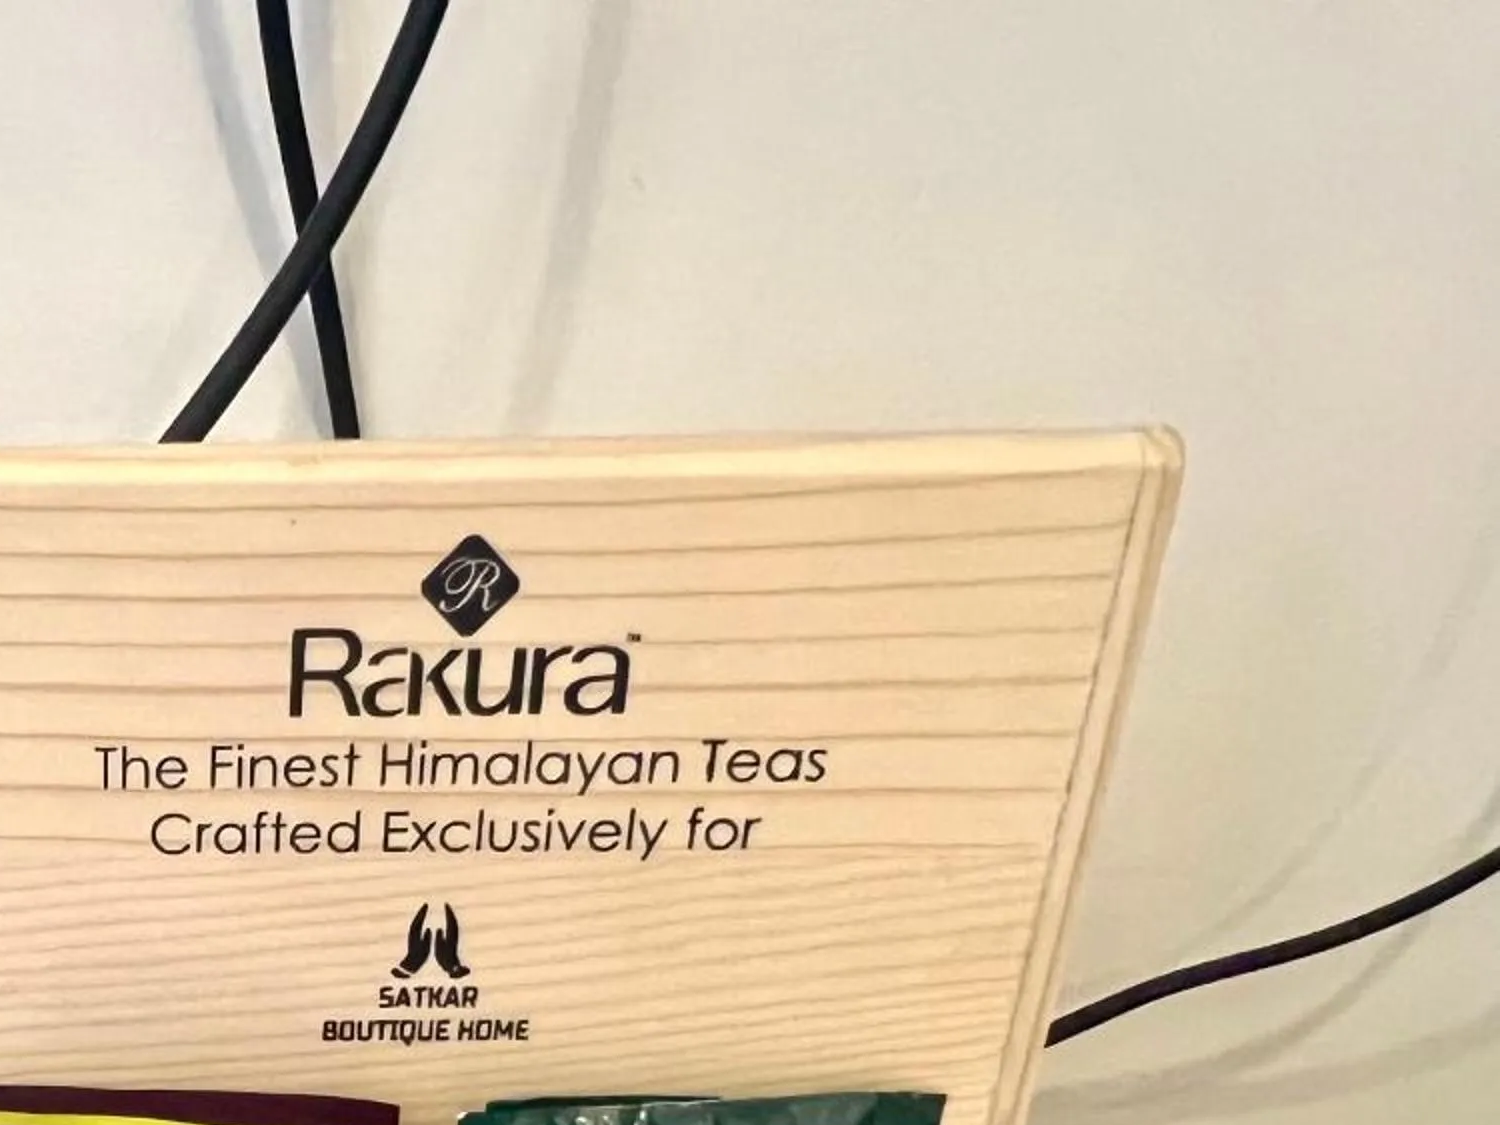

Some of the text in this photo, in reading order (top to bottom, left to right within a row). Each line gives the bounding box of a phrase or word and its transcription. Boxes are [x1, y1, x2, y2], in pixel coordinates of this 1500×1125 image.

[95, 738, 828, 795] The Finest Himalayan Teas
[150, 807, 762, 861] Crafted Exclusively for
[379, 985, 479, 1010] SATKAR
[322, 1019, 530, 1045] BOUTIQUE HOME
